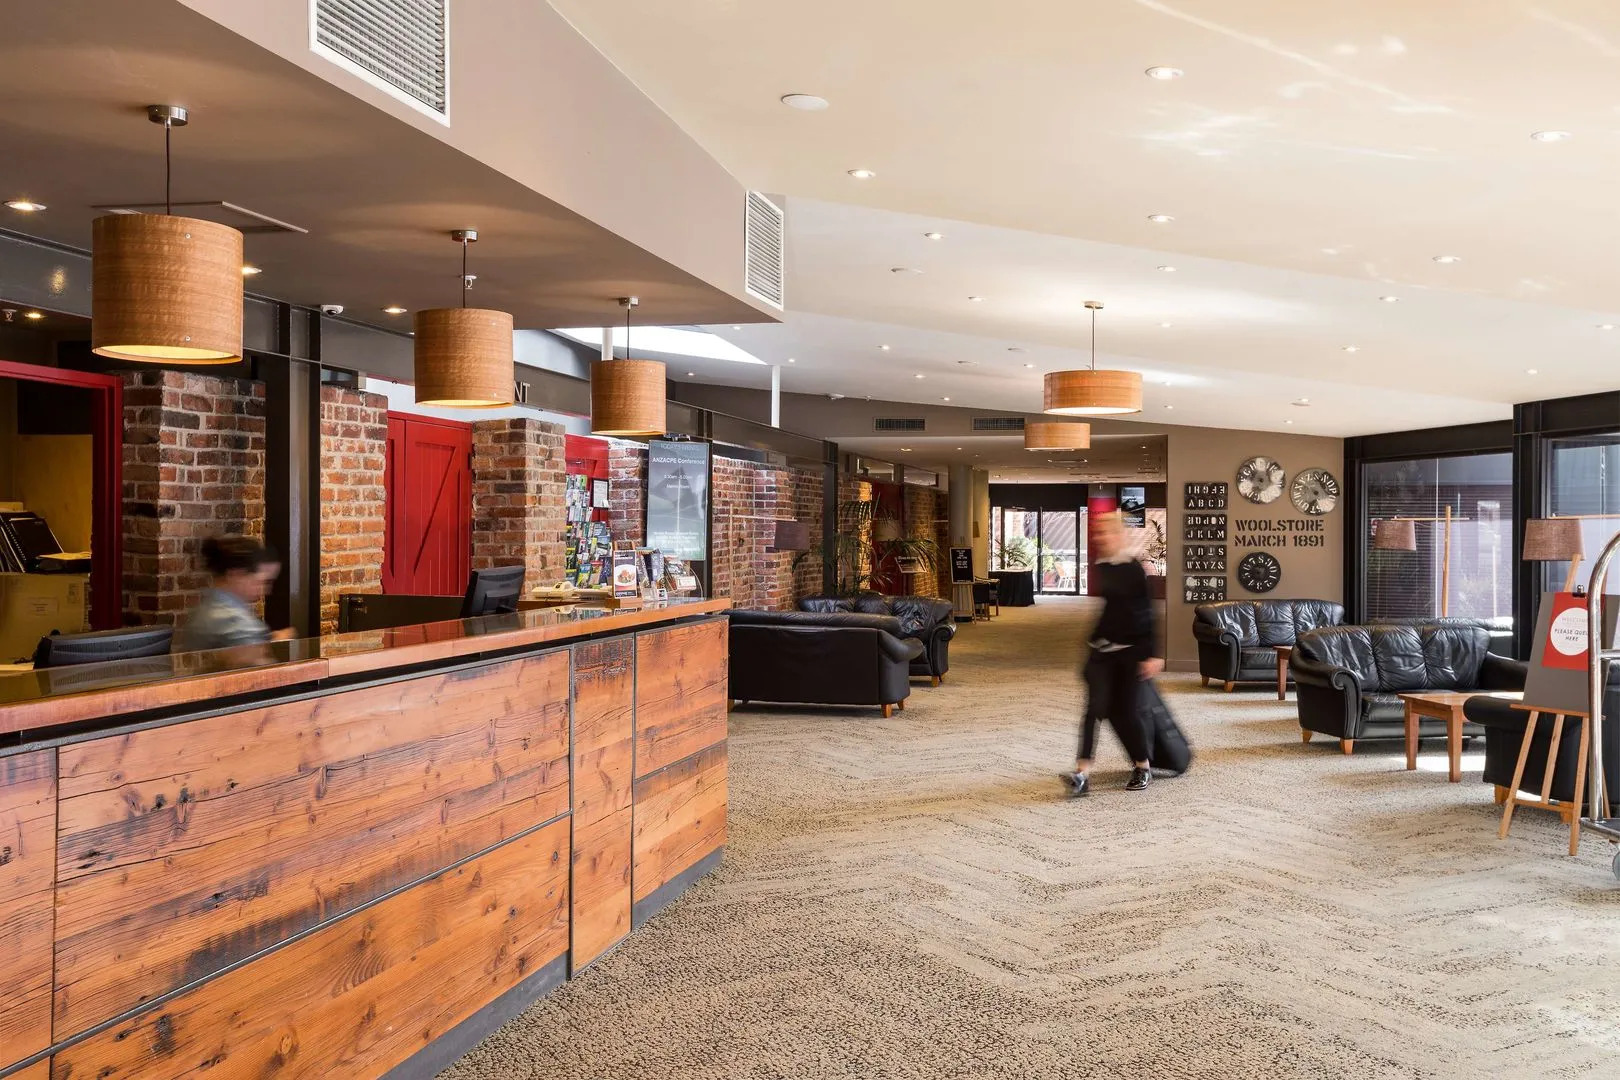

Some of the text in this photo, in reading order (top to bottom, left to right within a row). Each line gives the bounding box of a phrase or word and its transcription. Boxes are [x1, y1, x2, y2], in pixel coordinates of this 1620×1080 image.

[1235, 519, 1324, 532] WOOLSTORE
[1234, 535, 1324, 547] MARCH 1891
